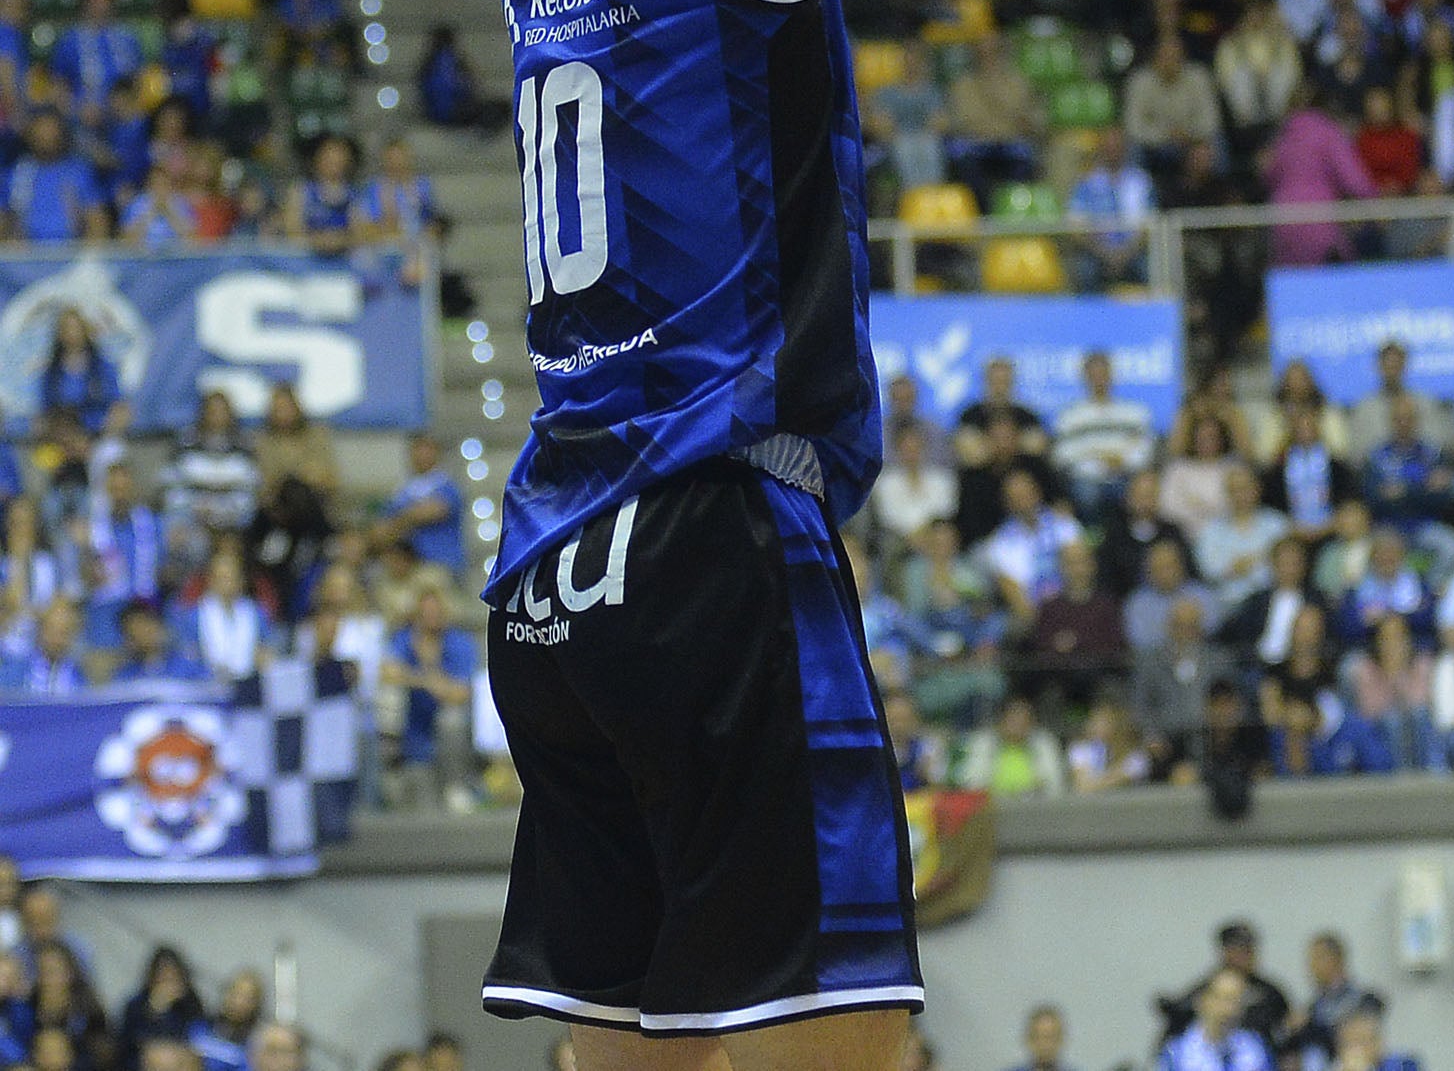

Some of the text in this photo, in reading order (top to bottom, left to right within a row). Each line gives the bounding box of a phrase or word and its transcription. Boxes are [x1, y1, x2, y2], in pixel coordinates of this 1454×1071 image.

[524, 4, 641, 47] RED HOSPITALARIA
[518, 61, 608, 305] 10
[197, 269, 365, 418] S
